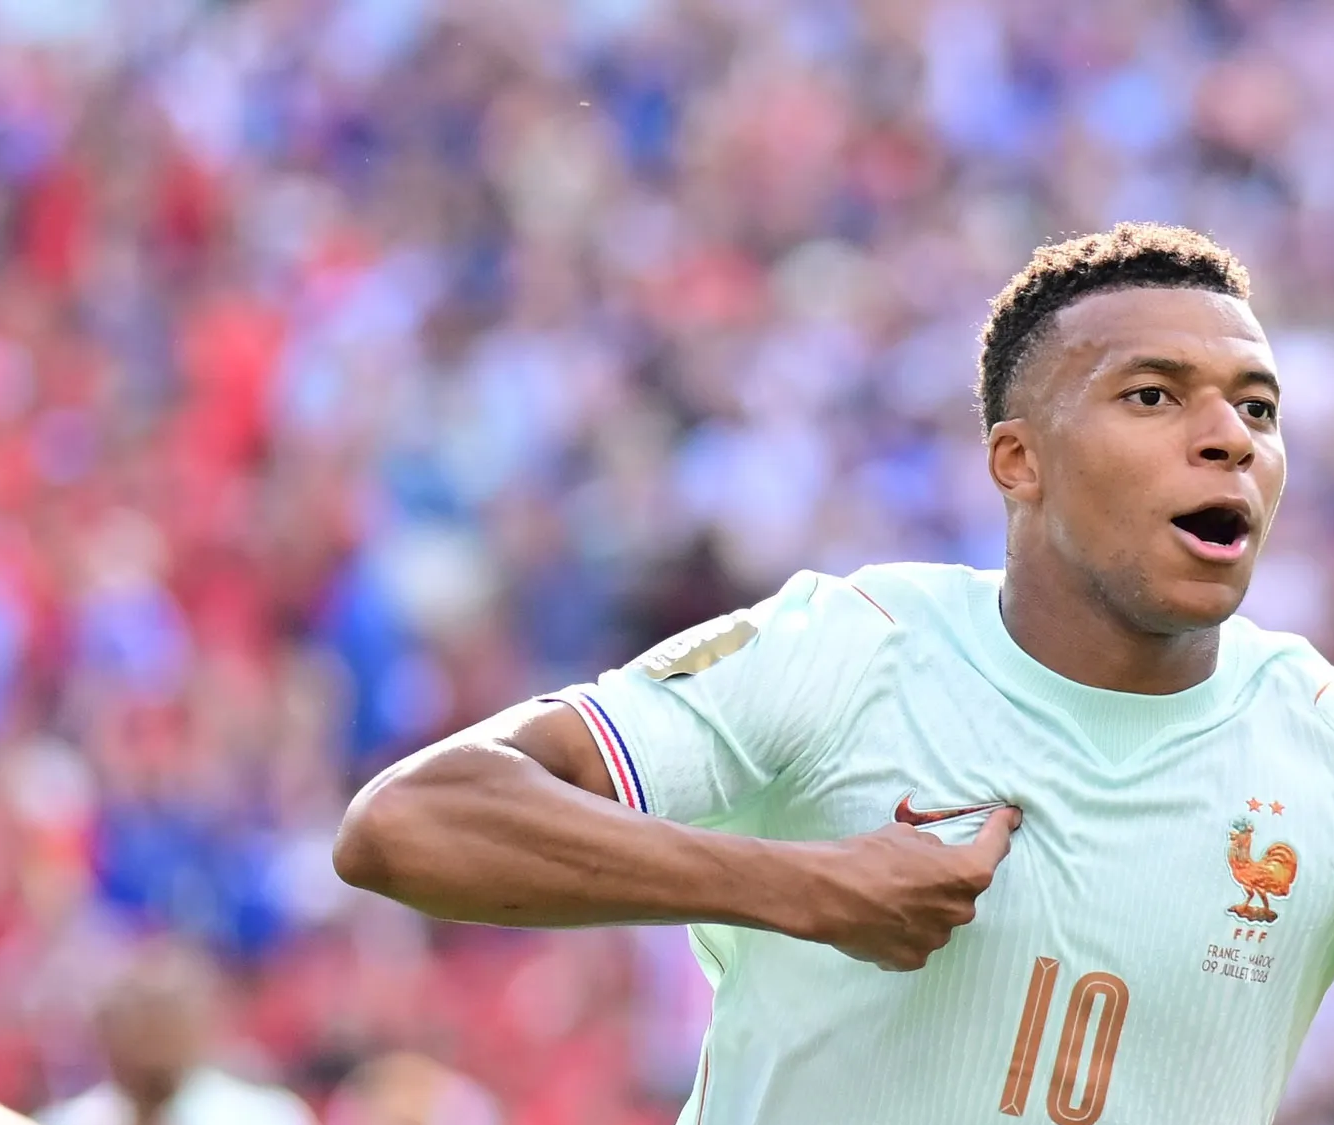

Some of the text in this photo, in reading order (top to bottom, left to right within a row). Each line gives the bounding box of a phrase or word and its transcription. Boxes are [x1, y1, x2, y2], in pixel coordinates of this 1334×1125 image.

[1207, 944, 1240, 962] FRANCE
[1202, 959, 1218, 973] 09
[1220, 963, 1249, 980] JUILLET
